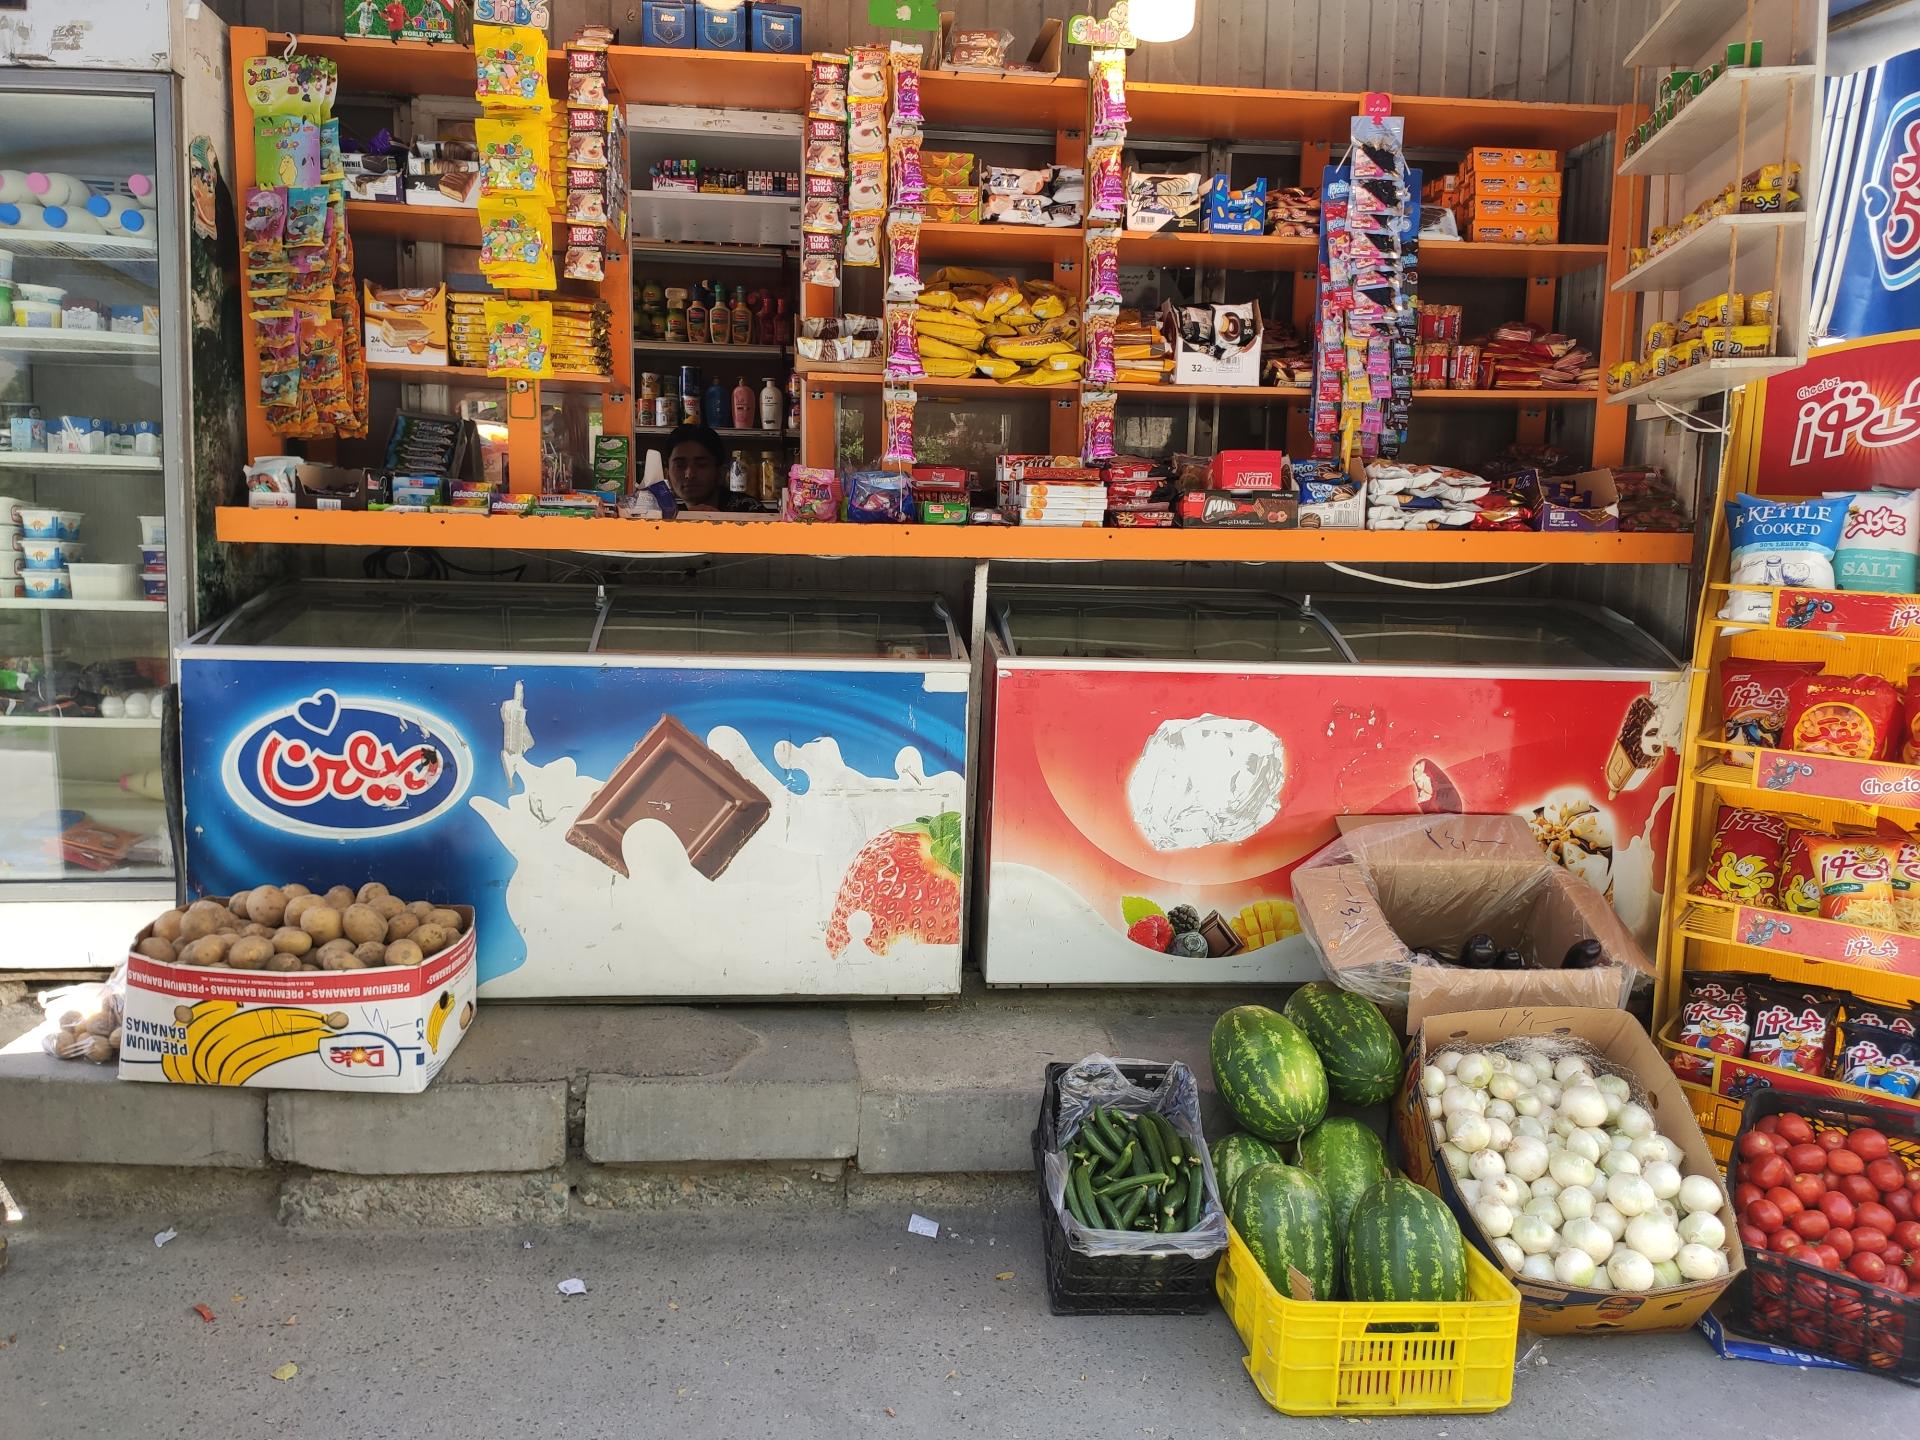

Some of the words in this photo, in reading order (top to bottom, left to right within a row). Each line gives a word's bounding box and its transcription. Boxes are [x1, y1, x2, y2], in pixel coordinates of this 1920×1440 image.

[660, 14, 676, 22] Nice
[712, 15, 728, 24] Nice
[770, 22, 785, 31] Nice
[572, 54, 595, 62] TORA
[817, 65, 839, 73] TORA
[572, 112, 595, 120] TORA
[574, 119, 595, 127] BIKA
[414, 182, 427, 191] 24
[574, 176, 595, 184] BIKA
[1191, 364, 1202, 372] 32
[1797, 377, 1840, 400] Cheetoz
[1747, 504, 1833, 523] KETTLE
[1753, 522, 1821, 537] COOKED
[1841, 561, 1902, 578] SALT
[257, 729, 440, 808] میهن
[127, 970, 163, 988] BANANAS
[163, 977, 205, 994] PREMIUM
[210, 984, 256, 997] BANANAS
[257, 985, 304, 999] PREMIUM
[311, 984, 361, 998] BANANAS
[362, 981, 411, 996] PREMIUM
[126, 1017, 187, 1039] BANANAS
[126, 1037, 188, 1056] PREMIUM
[329, 1049, 385, 1069] Dole
